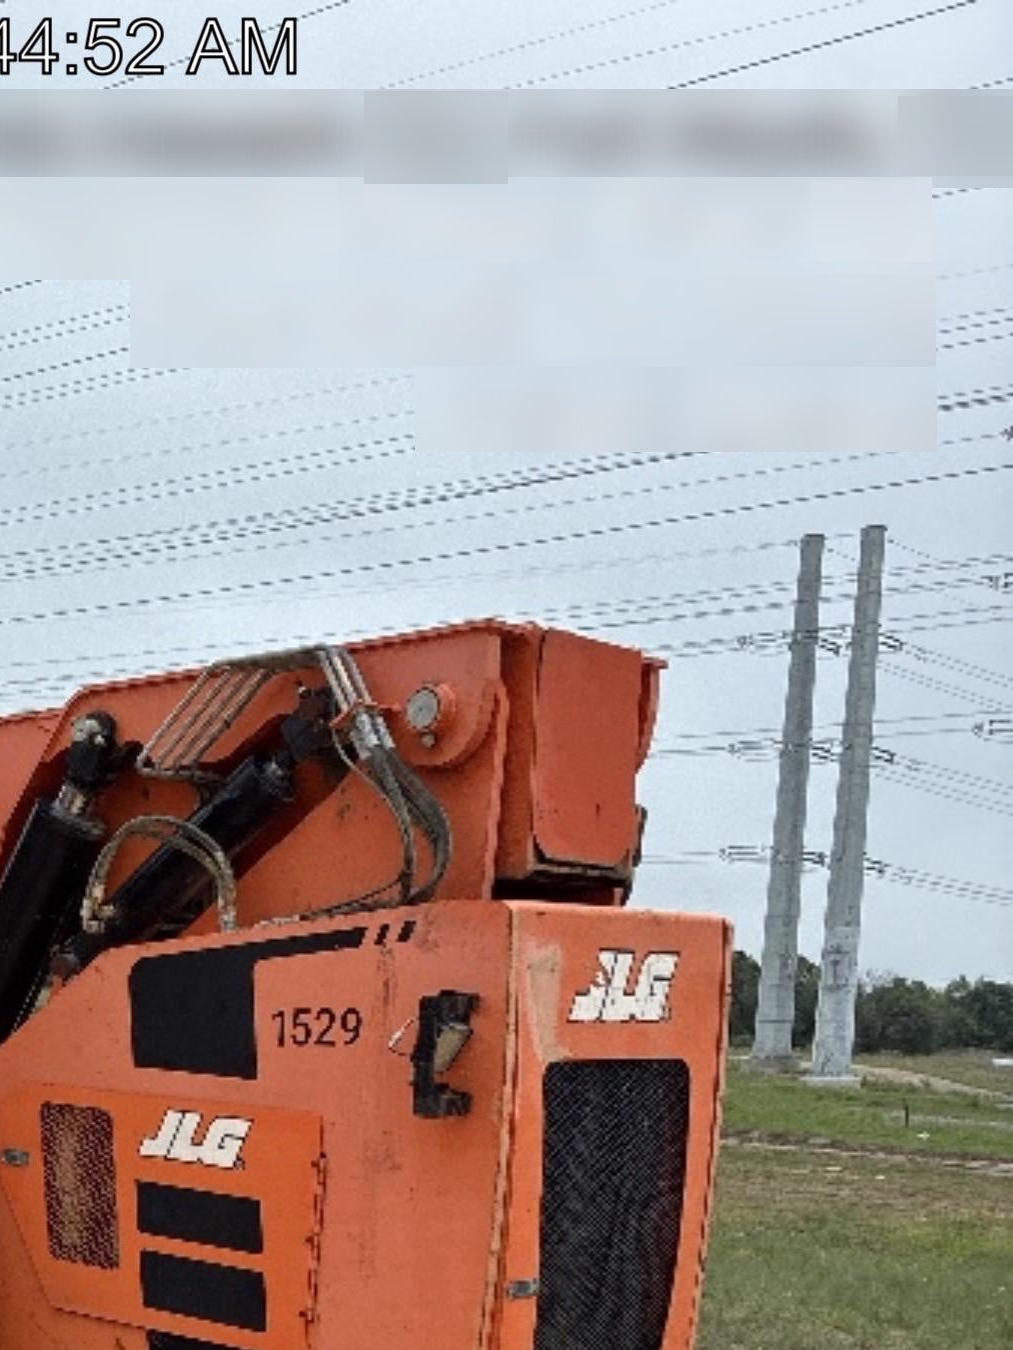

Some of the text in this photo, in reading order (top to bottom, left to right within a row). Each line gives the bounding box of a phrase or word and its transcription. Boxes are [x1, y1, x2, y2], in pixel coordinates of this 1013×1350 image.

[566, 948, 681, 1024] JLG
[271, 1007, 363, 1048] 1529
[138, 1107, 254, 1169] JLG
